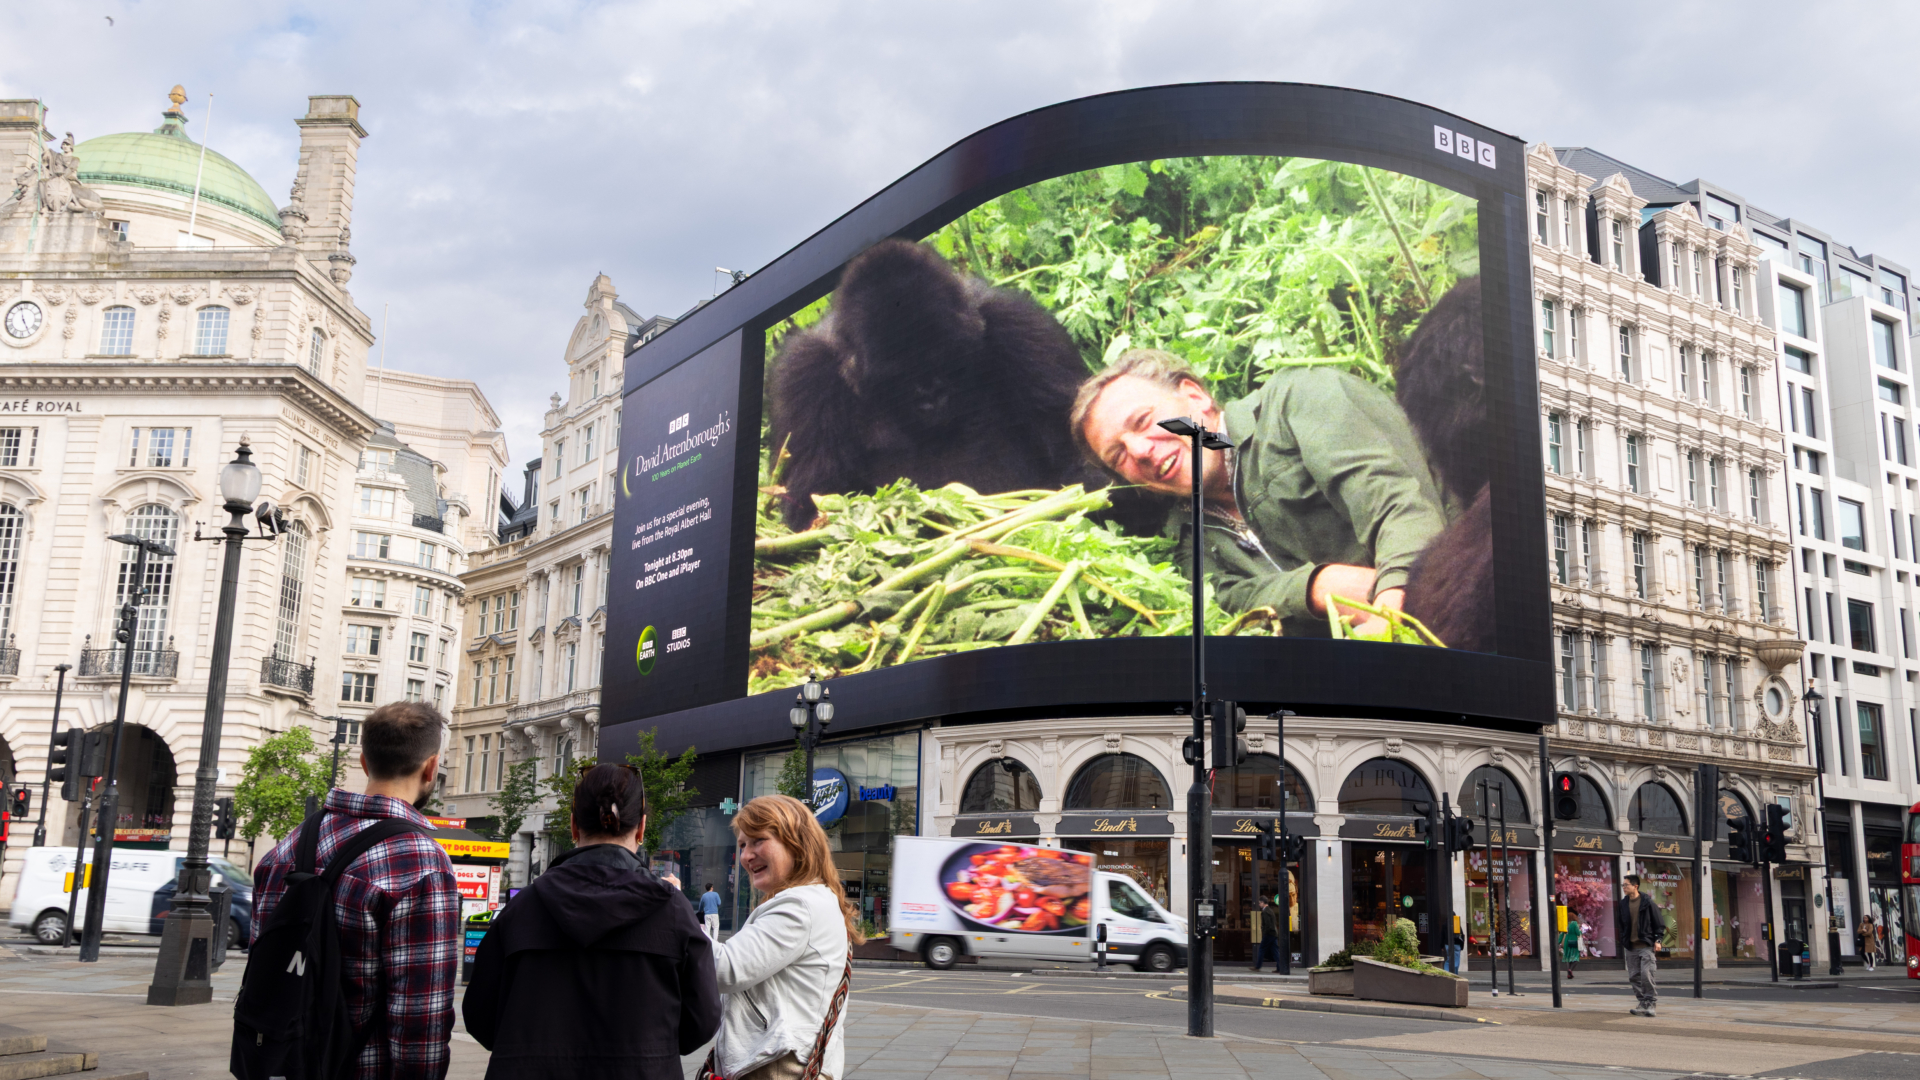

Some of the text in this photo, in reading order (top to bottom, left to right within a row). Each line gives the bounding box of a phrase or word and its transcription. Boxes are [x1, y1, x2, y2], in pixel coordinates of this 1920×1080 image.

[1437, 128, 1493, 165] BBC
[0, 399, 82, 412] AFÉ ROYAL
[282, 407, 338, 449] ALLIANCE LIFE OFFICE
[669, 413, 689, 435] BBC
[636, 445, 660, 476] David
[660, 467, 670, 478] Years
[671, 464, 677, 473] on
[677, 459, 689, 470] Planet
[690, 452, 702, 463] Earth
[635, 523, 646, 535] Join
[646, 521, 653, 530] us
[666, 505, 685, 523] special
[686, 498, 710, 513] evening,
[632, 508, 712, 550] live from the Royal Albert Hall
[644, 548, 694, 572] Tonight at 8.30pm
[635, 560, 701, 589] On BBC One and iPlayer
[666, 638, 691, 653] STUDIOS
[639, 648, 656, 661] EARTH
[40, 683, 107, 692] ALIANCE
[859, 783, 896, 802] beauty
[976, 821, 1005, 834] Lindt
[1091, 819, 1128, 832] Lindt
[1232, 819, 1265, 833] Lin
[1373, 824, 1408, 837] Lindt
[454, 844, 470, 852] DOG
[472, 845, 491, 853] SPOT
[1573, 836, 1597, 849] Lindt
[1653, 841, 1675, 854] Lindt
